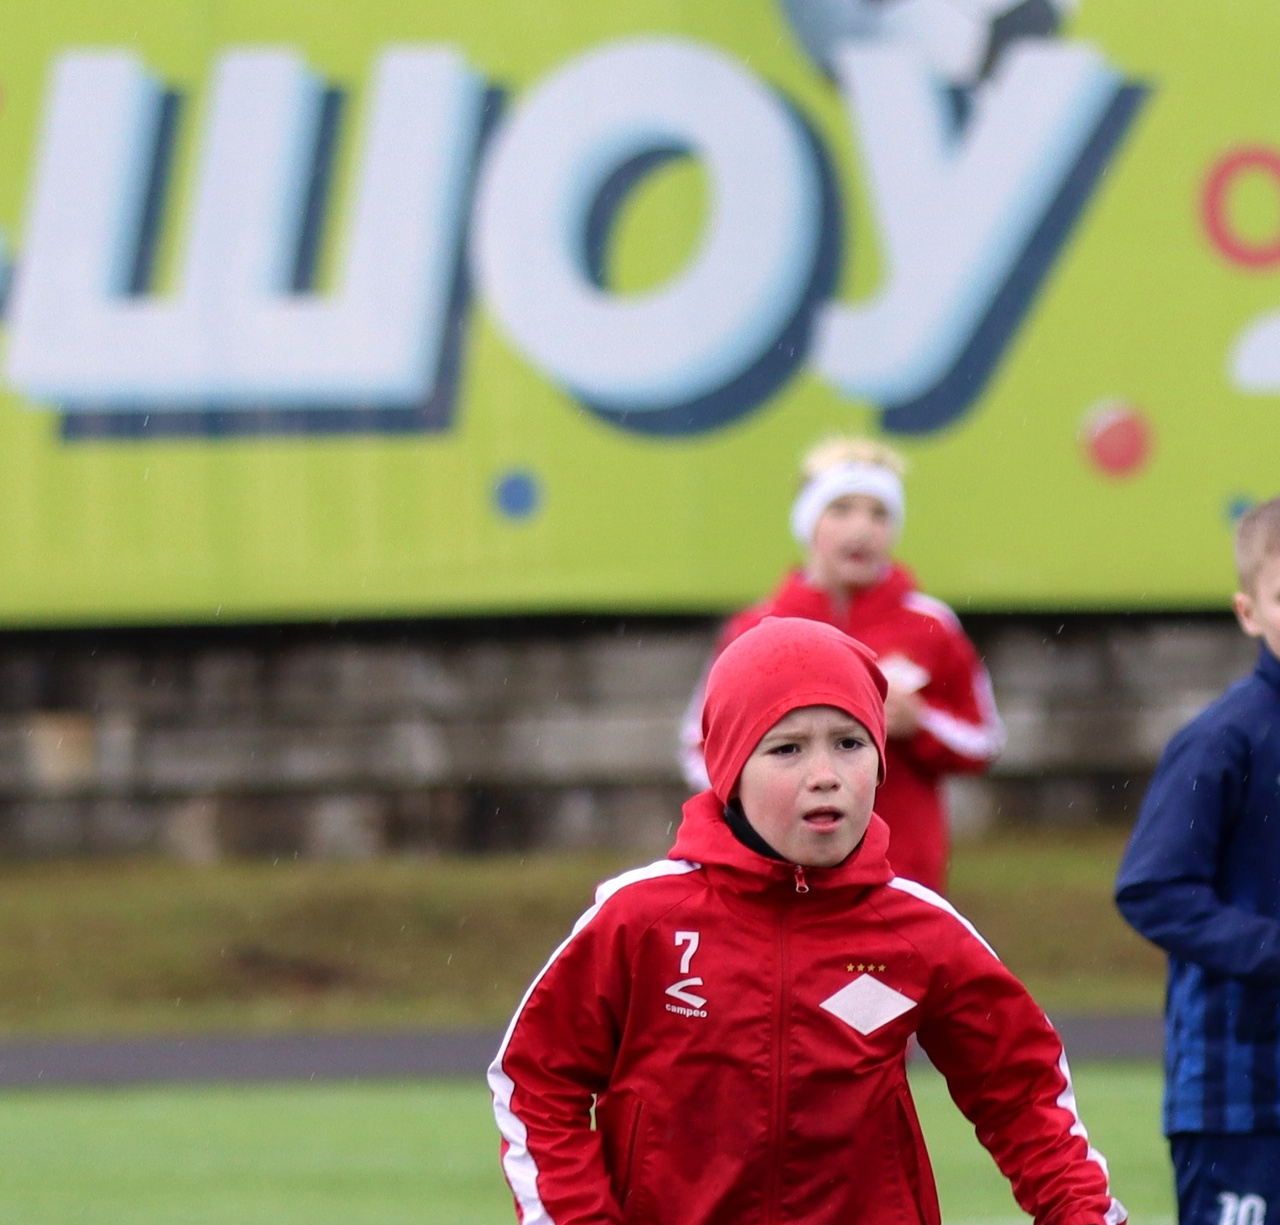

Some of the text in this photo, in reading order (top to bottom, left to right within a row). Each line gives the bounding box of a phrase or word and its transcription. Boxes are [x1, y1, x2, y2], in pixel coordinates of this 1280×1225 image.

[3, 34, 1150, 434] ШОУ
[674, 931, 700, 974] 7
[665, 1003, 708, 1018] campeo
